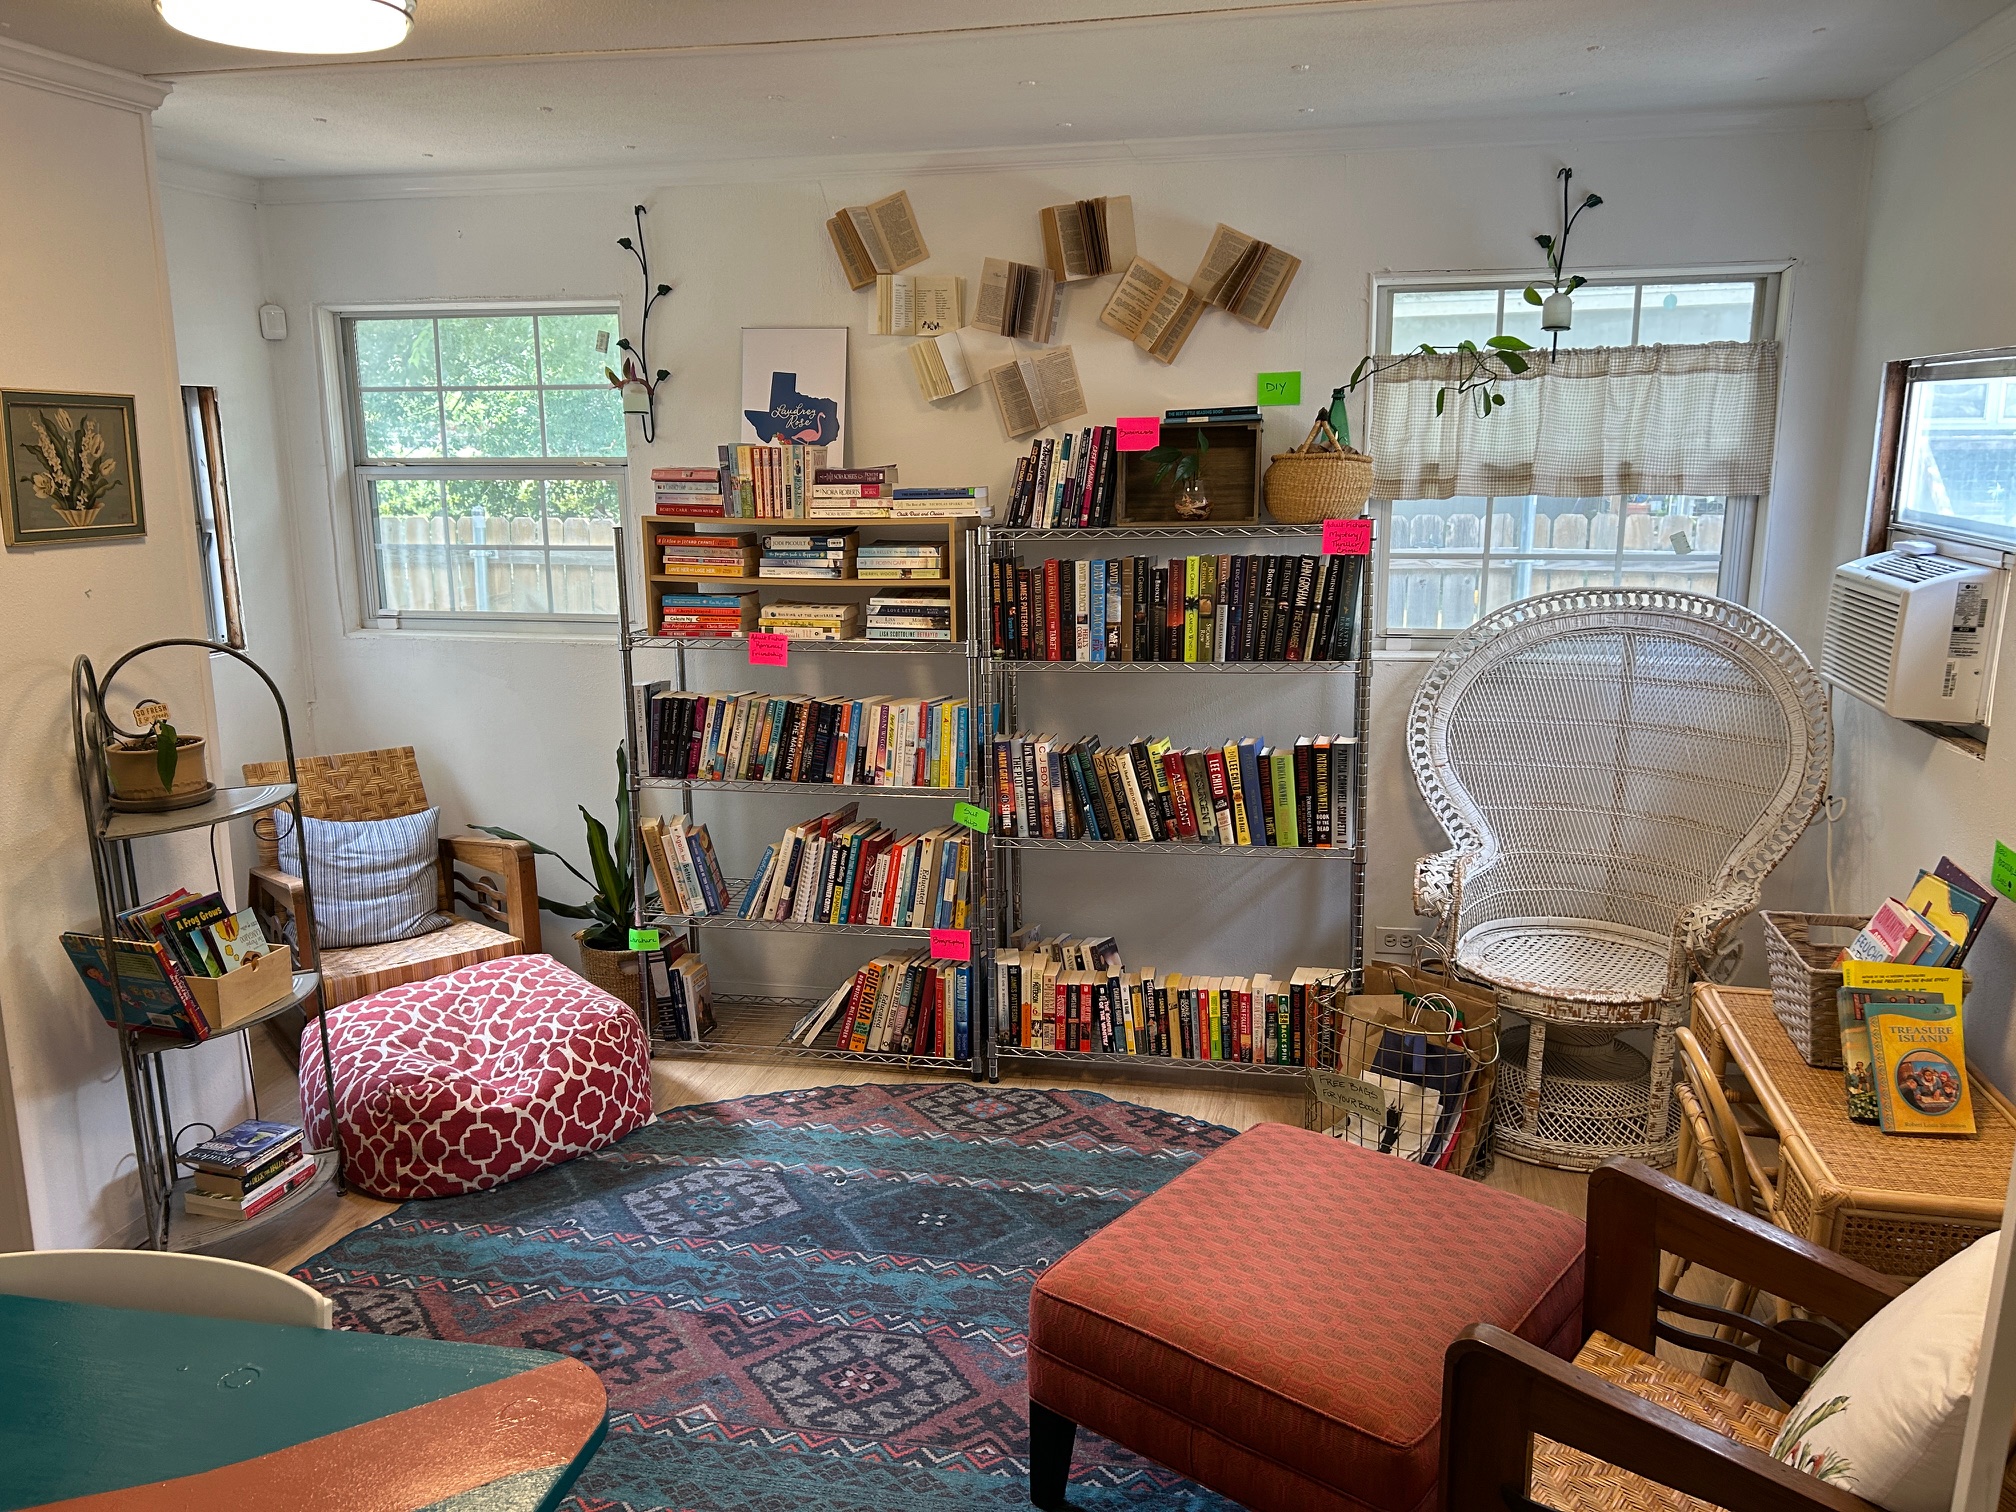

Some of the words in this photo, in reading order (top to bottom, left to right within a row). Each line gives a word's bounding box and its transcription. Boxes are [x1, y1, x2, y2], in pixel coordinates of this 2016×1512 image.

[1266, 382, 1286, 394] DIY
[786, 415, 812, 429] Rose
[1119, 428, 1154, 438] Business
[1026, 446, 1038, 482] BOLD
[1094, 564, 1104, 590] DAVID
[1109, 562, 1118, 584] DAVID
[1301, 558, 1314, 576] JOHN
[1265, 568, 1275, 597] BROKER
[1295, 577, 1311, 607] GRISHAM
[1048, 586, 1056, 619] BALDACCI
[1020, 602, 1028, 636] PATTERSON
[1094, 594, 1103, 636] BALDACCI
[1092, 639, 1100, 651] FIX
[1258, 630, 1267, 660] GRISHAM
[147, 704, 167, 714] FRESH
[792, 721, 800, 735] THE
[785, 736, 797, 770] MARTIAN
[1039, 746, 1046, 755] C.
[1080, 752, 1089, 769] DAVID
[1338, 750, 1347, 773] PATRICIA
[1013, 756, 1021, 770] THE
[1137, 759, 1152, 789] DEAVER
[1209, 759, 1220, 773] LEE
[1228, 760, 1237, 773] LEE
[1276, 758, 1285, 780] PATRICIA
[1316, 754, 1327, 780] PATRICIA
[1014, 772, 1023, 788] PLOT
[1211, 774, 1224, 795] CHILD
[1230, 773, 1241, 791] CHILD
[1337, 775, 1347, 803] CORNWELL
[1172, 773, 1190, 826] ALLEGIANT
[1194, 771, 1211, 826] INSURGENT
[1278, 781, 1288, 807] CORNWELL
[1316, 781, 1328, 813] CORNWELL
[1002, 804, 1011, 829] SENTINEL
[1337, 806, 1347, 836] SCARPETTA
[828, 850, 838, 879] DISARMING
[840, 850, 848, 866] House
[837, 866, 846, 882] Selling
[826, 882, 834, 898] INNER
[918, 869, 929, 905] Educated
[823, 898, 831, 914] CRITIC
[176, 921, 183, 930] A
[183, 915, 200, 927] Frog
[200, 907, 222, 920] Grows
[852, 985, 861, 1001] NOTICE
[857, 968, 880, 1020] GUEVARA
[875, 994, 889, 1028] Educated
[842, 1017, 852, 1039] BROWDER
[1889, 1025, 1954, 1035] TREASURE
[1898, 1034, 1948, 1043] ISLAND
[1319, 1075, 1345, 1088] FREE
[1349, 1083, 1378, 1100] BAGS
[1322, 1088, 1336, 1100] FOR
[1336, 1093, 1357, 1108] YOUR
[1358, 1101, 1381, 1115] BOOKS
